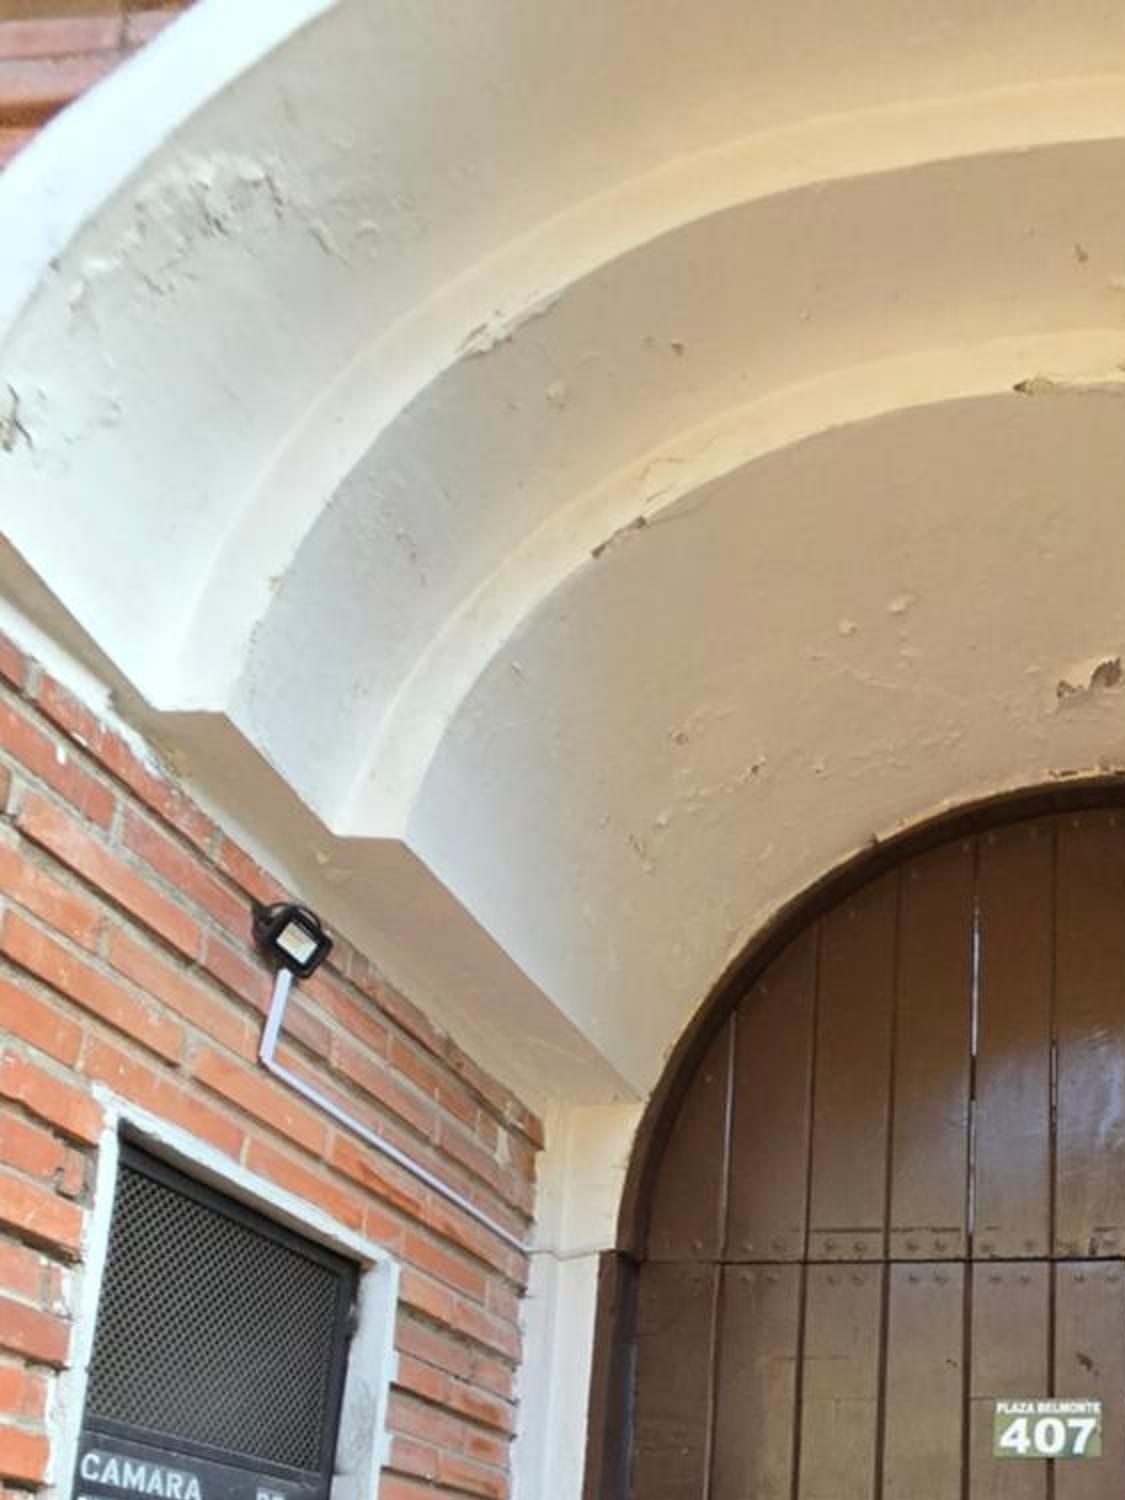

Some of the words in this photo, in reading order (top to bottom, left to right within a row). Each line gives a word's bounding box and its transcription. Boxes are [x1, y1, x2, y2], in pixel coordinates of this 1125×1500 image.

[996, 1401, 1035, 1414] PLAZA
[1037, 1400, 1102, 1414] BELMONTE
[999, 1417, 1097, 1455] 407
